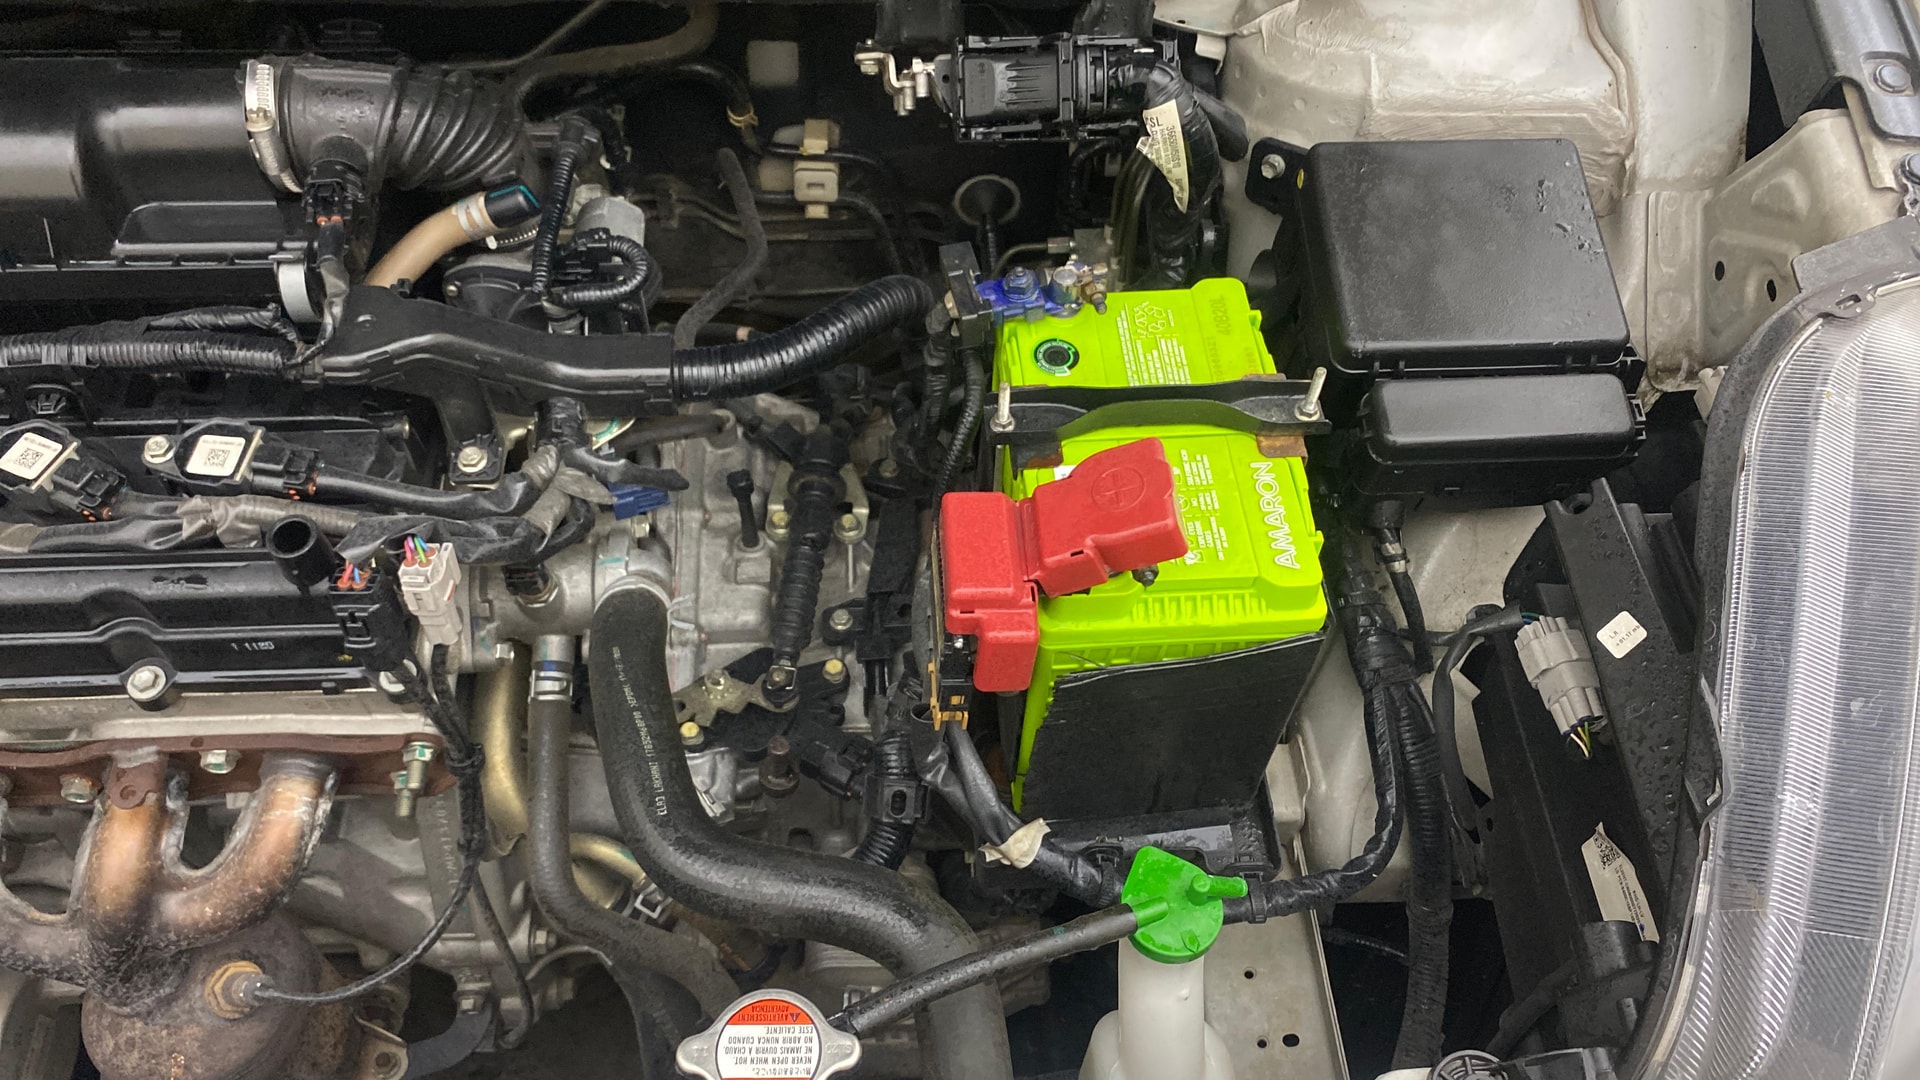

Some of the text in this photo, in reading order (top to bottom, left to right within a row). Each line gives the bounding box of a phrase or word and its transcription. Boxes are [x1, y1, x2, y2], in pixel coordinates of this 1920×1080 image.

[1249, 461, 1301, 569] AMARON
[649, 762, 664, 793] LAKHANI
[738, 1013, 789, 1021] AVERTISSEMENT
[764, 1026, 814, 1034] ESTE CALIENTE.
[728, 1036, 813, 1044] NO ABRIR NUNCA CUANDO
[723, 1046, 746, 1054] CHAUD.
[755, 1046, 778, 1054] OUVRIR
[780, 1046, 803, 1054] JAMAIS
[804, 1046, 812, 1054] NE
[732, 1056, 812, 1064] NEVER OPEN WHEN HOT.
